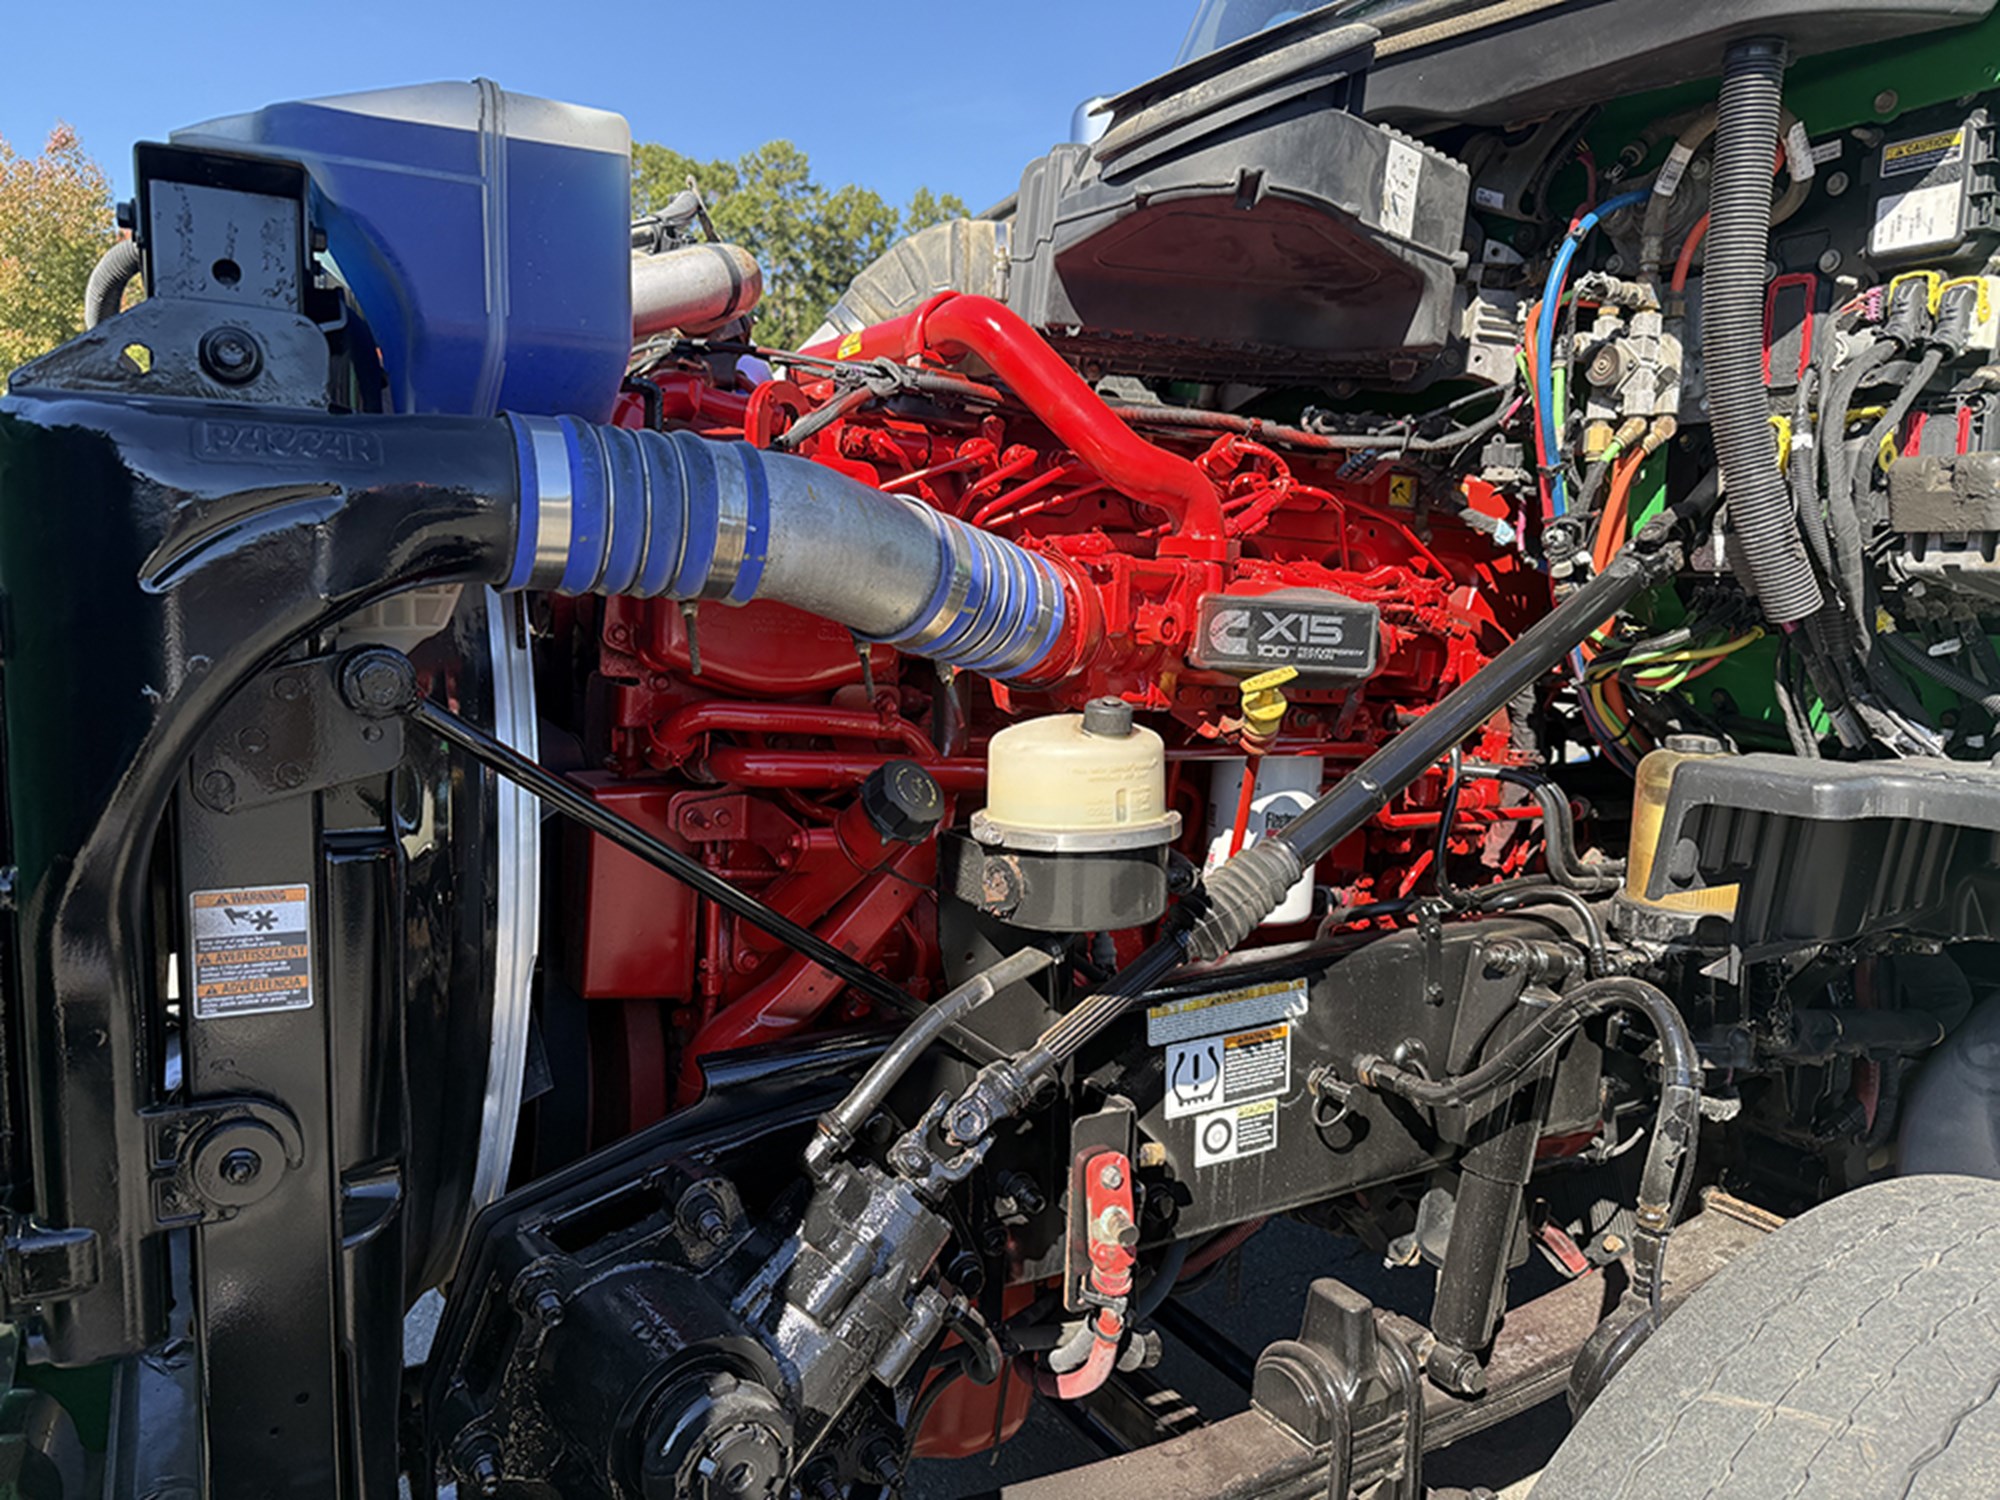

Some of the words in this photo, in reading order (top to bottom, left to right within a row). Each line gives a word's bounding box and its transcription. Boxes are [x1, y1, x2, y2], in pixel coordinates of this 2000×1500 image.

[1906, 134, 1951, 151] CAUTION
[203, 422, 369, 461] PACCAR
[1258, 611, 1345, 645] X15
[231, 890, 286, 905] WARNING
[215, 946, 305, 962] AVERTISSEMENT
[223, 977, 301, 992] ADVERTENCIA
